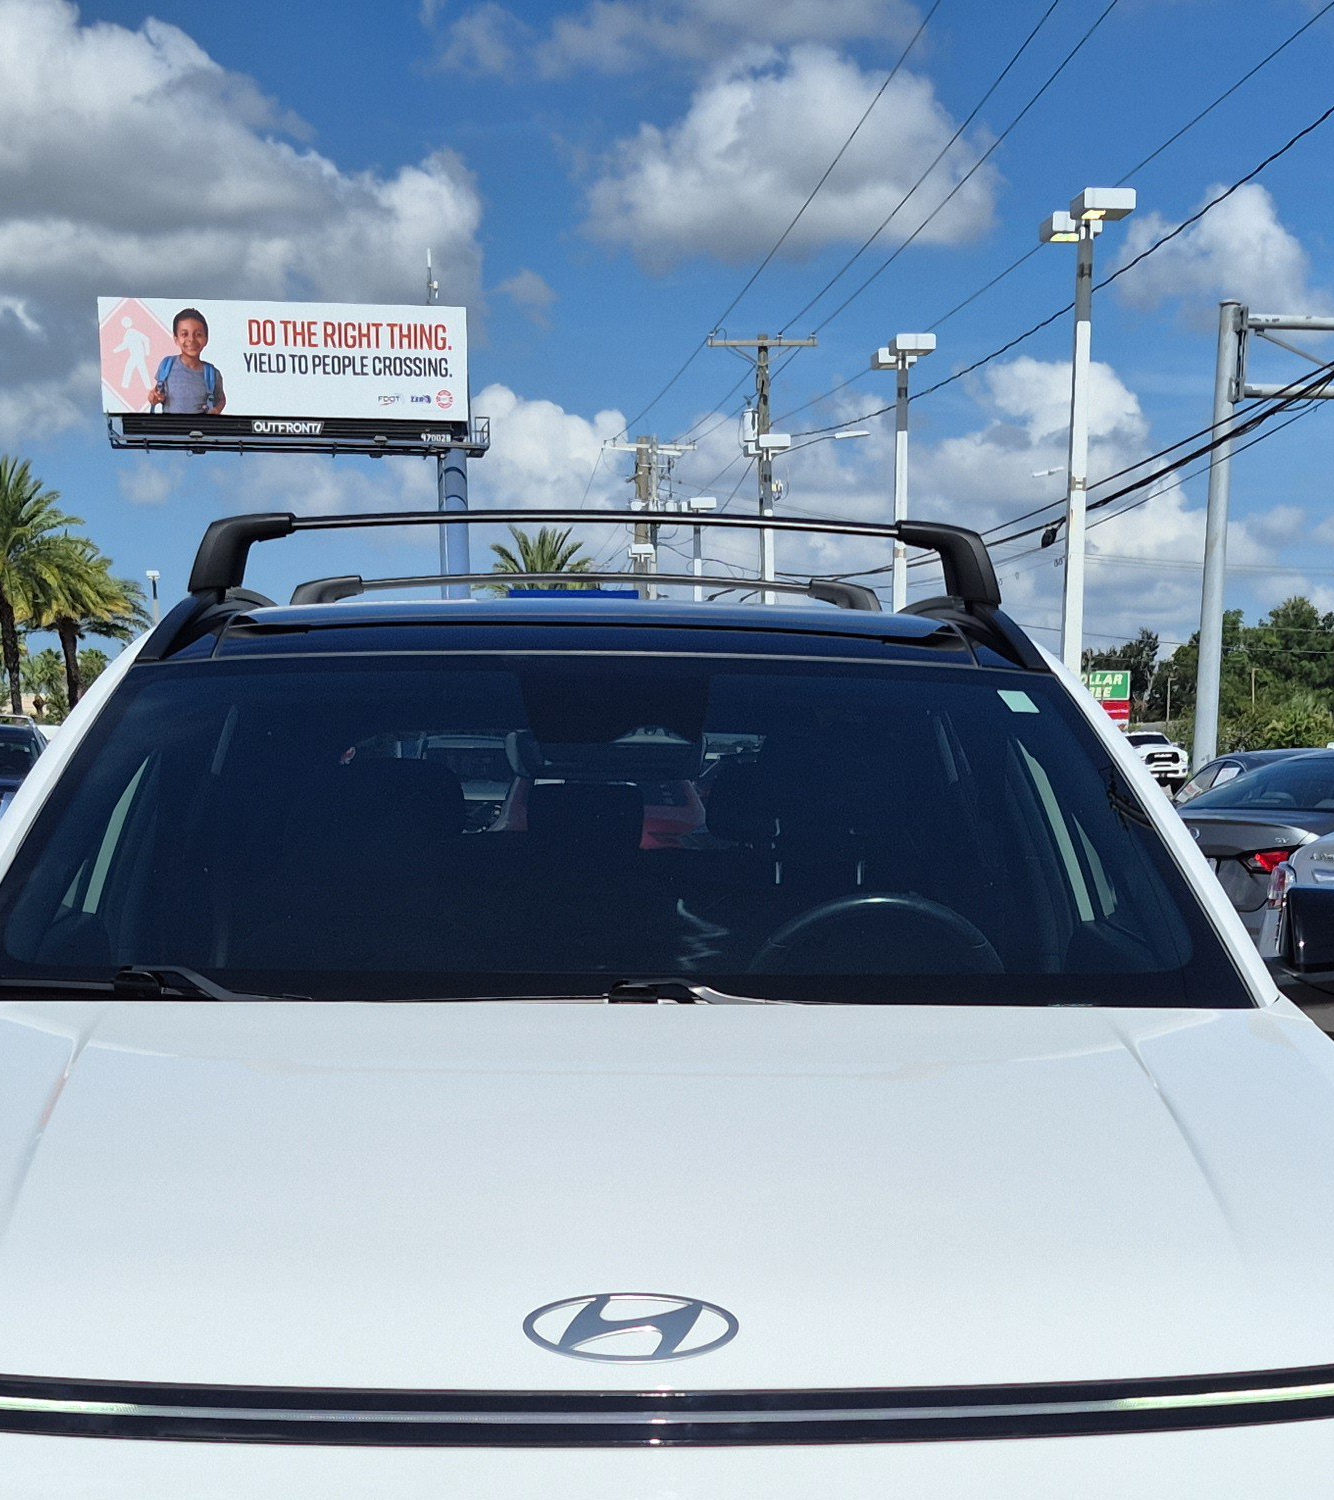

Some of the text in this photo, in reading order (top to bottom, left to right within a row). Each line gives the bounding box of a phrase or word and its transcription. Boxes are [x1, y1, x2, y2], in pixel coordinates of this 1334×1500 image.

[247, 319, 453, 351] DO THE RIGHT THING.
[243, 353, 453, 378] YIELD TO PEOPLE CROSSING.
